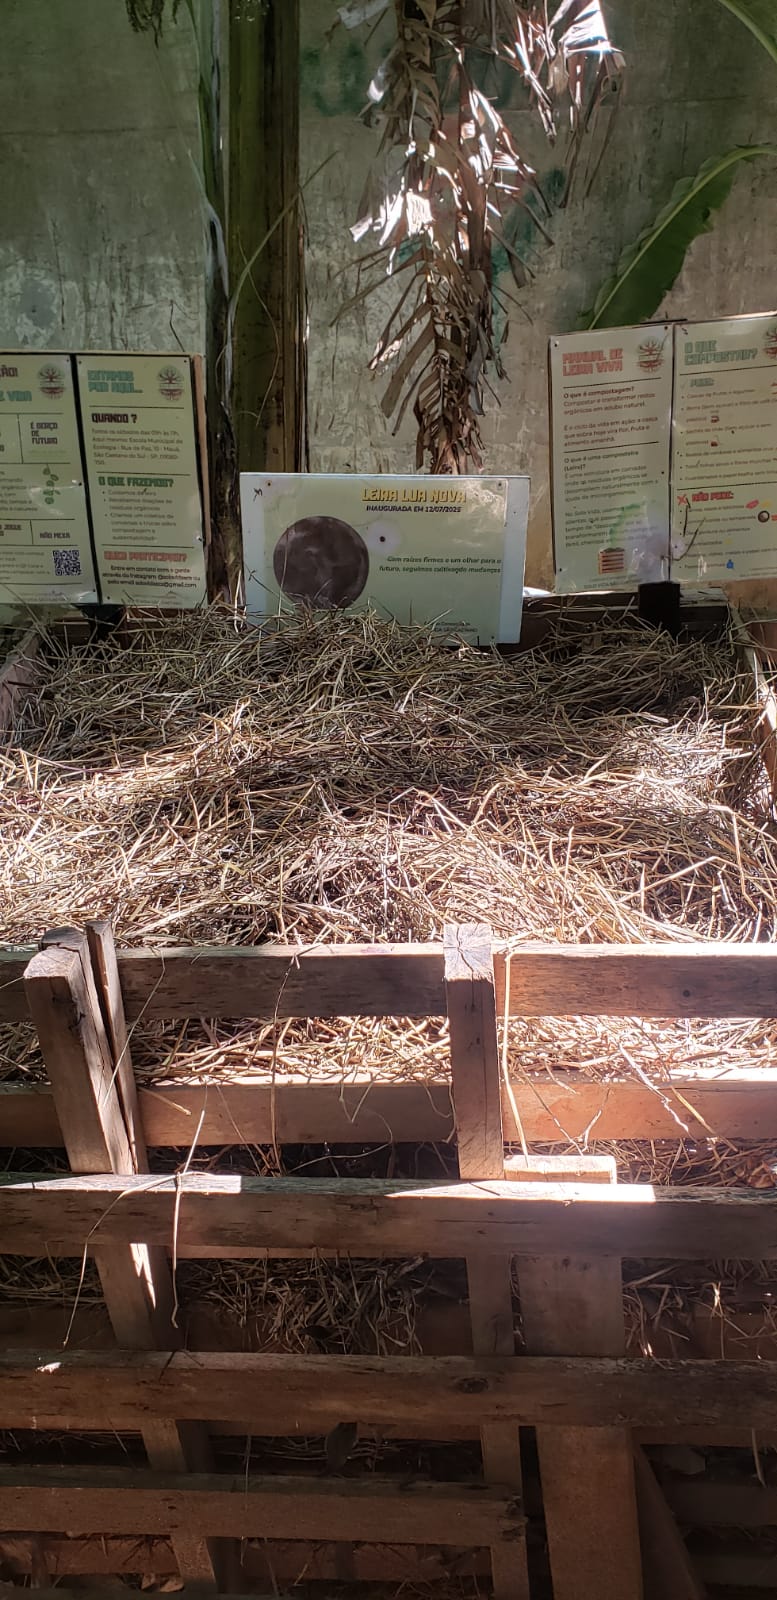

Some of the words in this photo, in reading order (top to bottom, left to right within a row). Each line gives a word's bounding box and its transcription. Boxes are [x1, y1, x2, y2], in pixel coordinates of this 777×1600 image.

[684, 342, 693, 353] O
[695, 340, 717, 353] QUE
[562, 351, 606, 364] MANUAL
[609, 348, 623, 359] DE
[685, 349, 758, 365] COMPOSTAR?
[0, 365, 18, 377] ÃO!
[595, 360, 623, 373] VIVA
[88, 371, 134, 381] ESTAMOS
[88, 382, 109, 393] POR
[588, 386, 635, 397] compostagem?
[7, 390, 32, 401] VIDA
[91, 413, 128, 423] QUANDO
[131, 413, 137, 423] ?
[99, 476, 105, 486] O
[108, 477, 125, 486] QUE
[127, 477, 174, 487] FAZEMOS?
[362, 488, 398, 502] LEIRA
[401, 488, 427, 503] LUA
[430, 489, 467, 503] NOVA
[691, 491, 709, 502] NÃO
